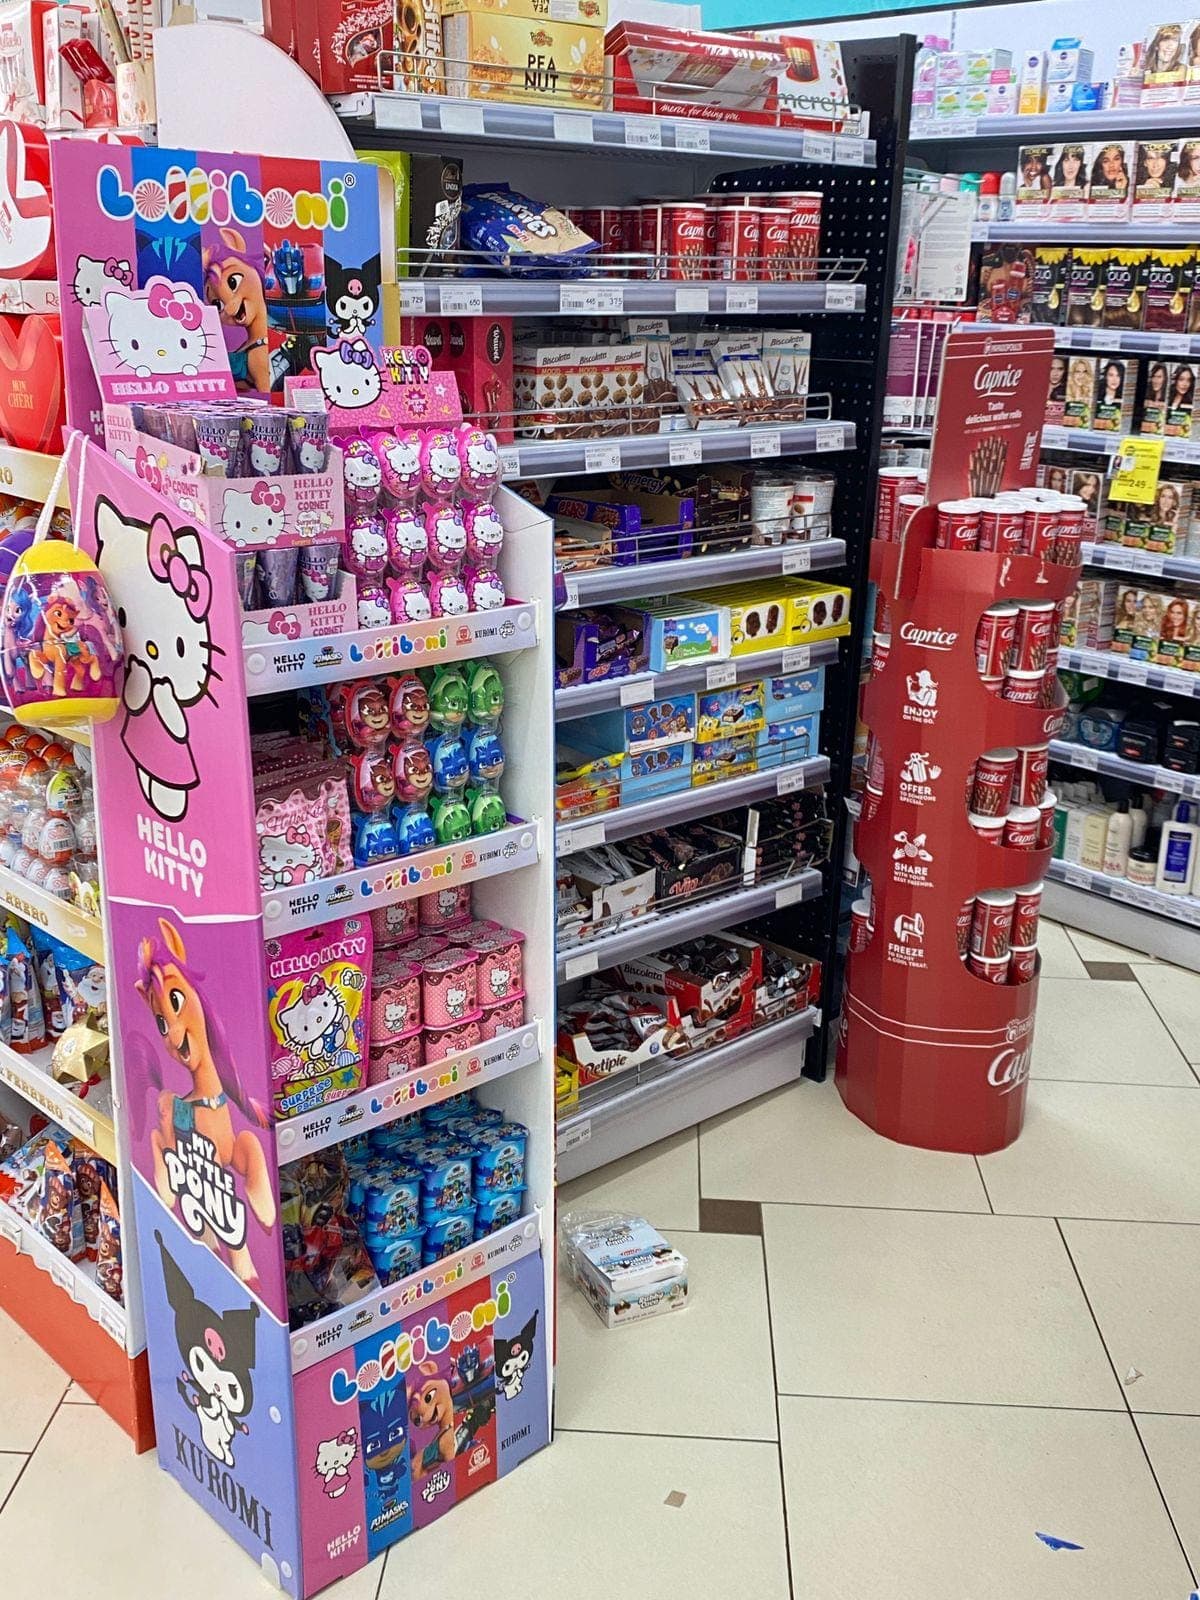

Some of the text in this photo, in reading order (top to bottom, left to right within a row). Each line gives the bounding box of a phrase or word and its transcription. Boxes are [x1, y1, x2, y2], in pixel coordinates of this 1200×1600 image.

[528, 54, 557, 71] PEA
[525, 70, 559, 93] NUT
[688, 105, 701, 118] for
[390, 365, 430, 385] KITTY
[974, 363, 1023, 394] Caprice
[11, 380, 26, 391] MON
[111, 378, 226, 397] HELLO KITTY
[107, 415, 132, 428] HELLO
[109, 429, 132, 442] KITTY
[294, 477, 334, 488] HELLO
[1129, 479, 1146, 489] 249
[295, 489, 332, 500] KITTY
[298, 500, 330, 511] CORNET
[309, 603, 347, 616] HELLO
[310, 614, 345, 627] KITTY
[900, 622, 959, 646] Caprice
[273, 653, 306, 665] HELLO
[276, 662, 304, 673] KITTY
[903, 705, 939, 719] ENJOY
[900, 783, 932, 796] OFFER
[136, 813, 207, 868] HELLO
[144, 847, 204, 898] KITTY
[894, 862, 928, 876] SHARE
[289, 893, 320, 909] HELLO
[291, 903, 318, 916] KITTY
[270, 937, 367, 979] HELLO KITTY
[888, 943, 924, 957] FREEZE
[624, 965, 663, 981] Biscolata
[281, 1078, 332, 1111] SURPRISE
[296, 1097, 323, 1114] PACK
[302, 1116, 331, 1134] HELLO
[305, 1125, 330, 1140] KITTY
[191, 1133, 215, 1157] MY
[177, 1140, 234, 1196] LITTLE
[164, 1152, 245, 1246] PONY
[316, 1323, 343, 1341] HELLO
[318, 1334, 342, 1348] KITTY
[500, 1425, 531, 1451] KUROMI
[172, 1423, 274, 1551] KUROMI
[422, 1474, 450, 1503] PONY
[327, 1524, 361, 1550] HELLO
[329, 1535, 359, 1559] KITTY
